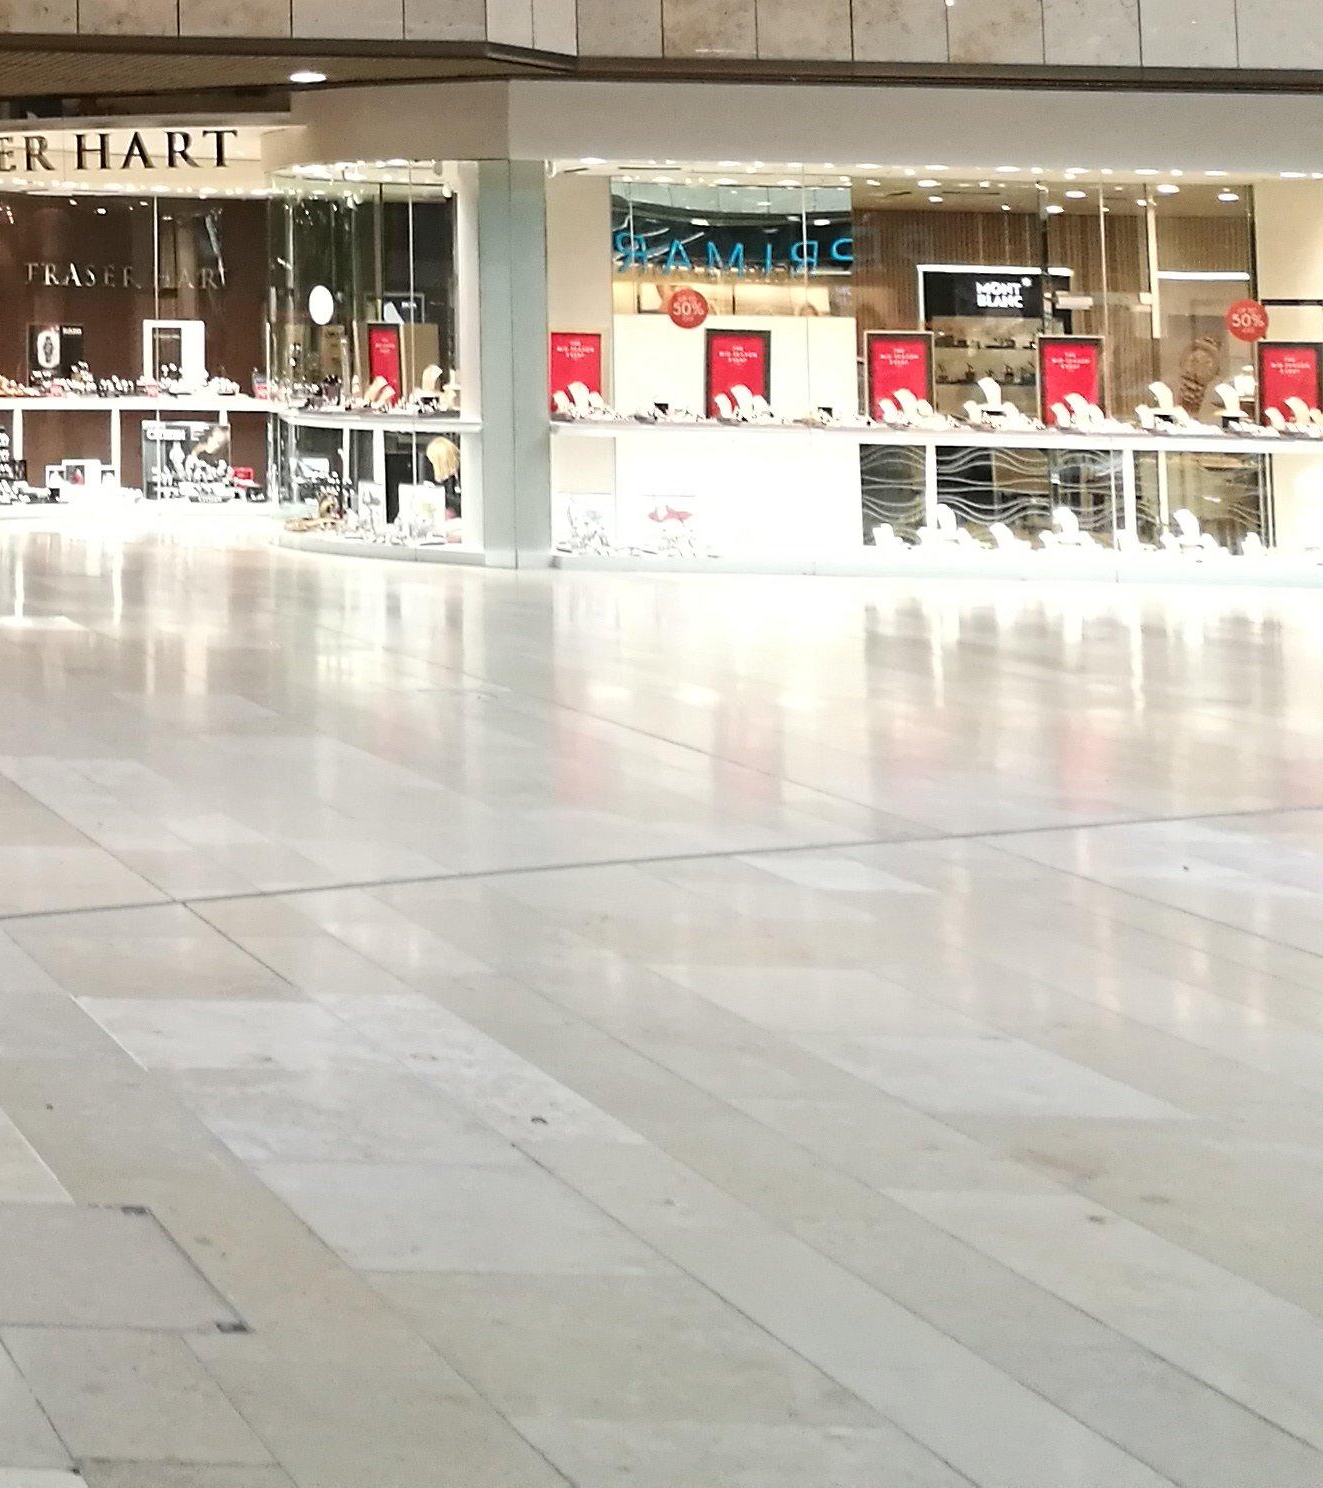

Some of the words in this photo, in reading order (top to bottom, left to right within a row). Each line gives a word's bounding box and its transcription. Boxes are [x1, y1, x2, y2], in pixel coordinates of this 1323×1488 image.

[74, 129, 237, 170] HART
[24, 262, 142, 290] FRASER
[975, 281, 1022, 296] MONT
[673, 301, 705, 316] 50%
[976, 294, 1024, 308] BLANC
[1231, 312, 1266, 328] 50%
